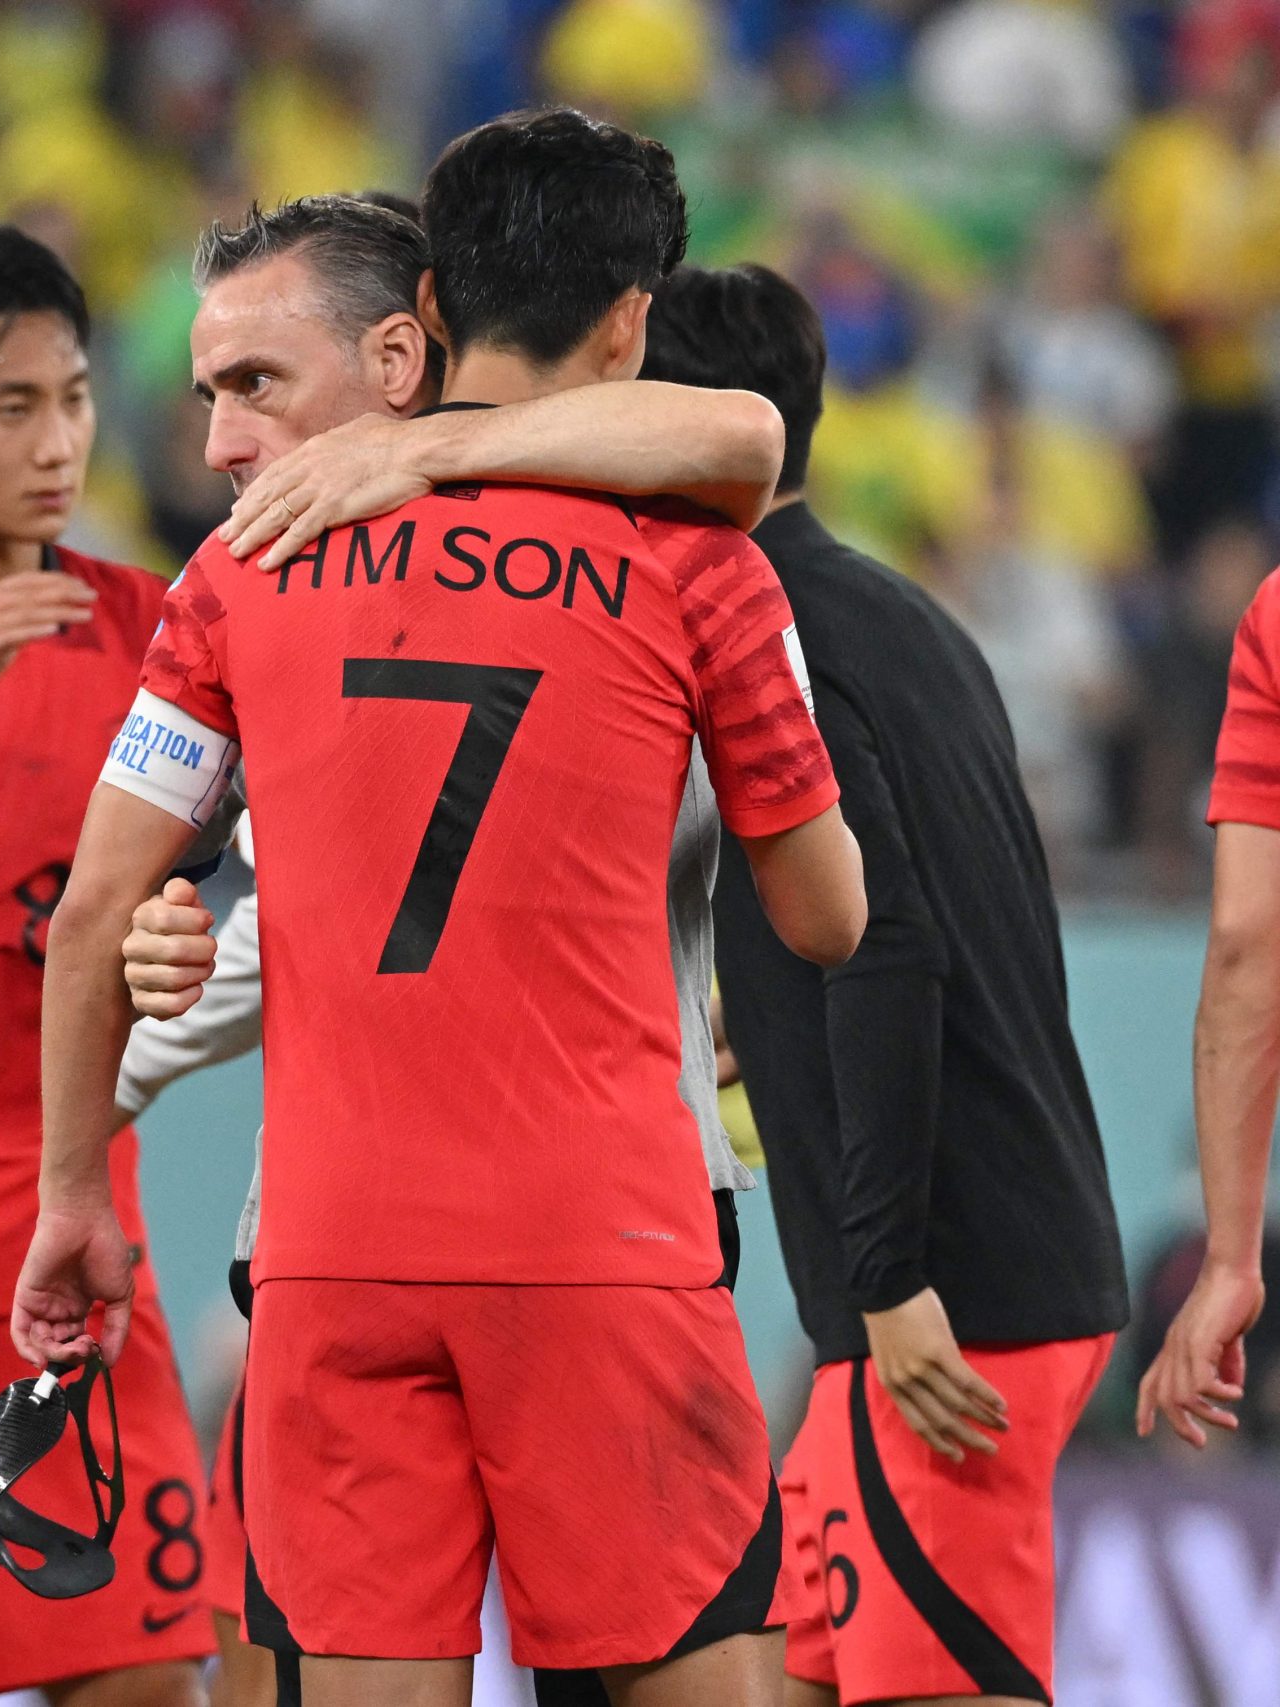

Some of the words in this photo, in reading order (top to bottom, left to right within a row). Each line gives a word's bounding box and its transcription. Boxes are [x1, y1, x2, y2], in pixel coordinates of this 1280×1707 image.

[434, 526, 630, 619] SON
[117, 742, 151, 774] ALL
[341, 657, 544, 975] 7
[144, 1478, 204, 1593] 8
[823, 1509, 860, 1631] 6
